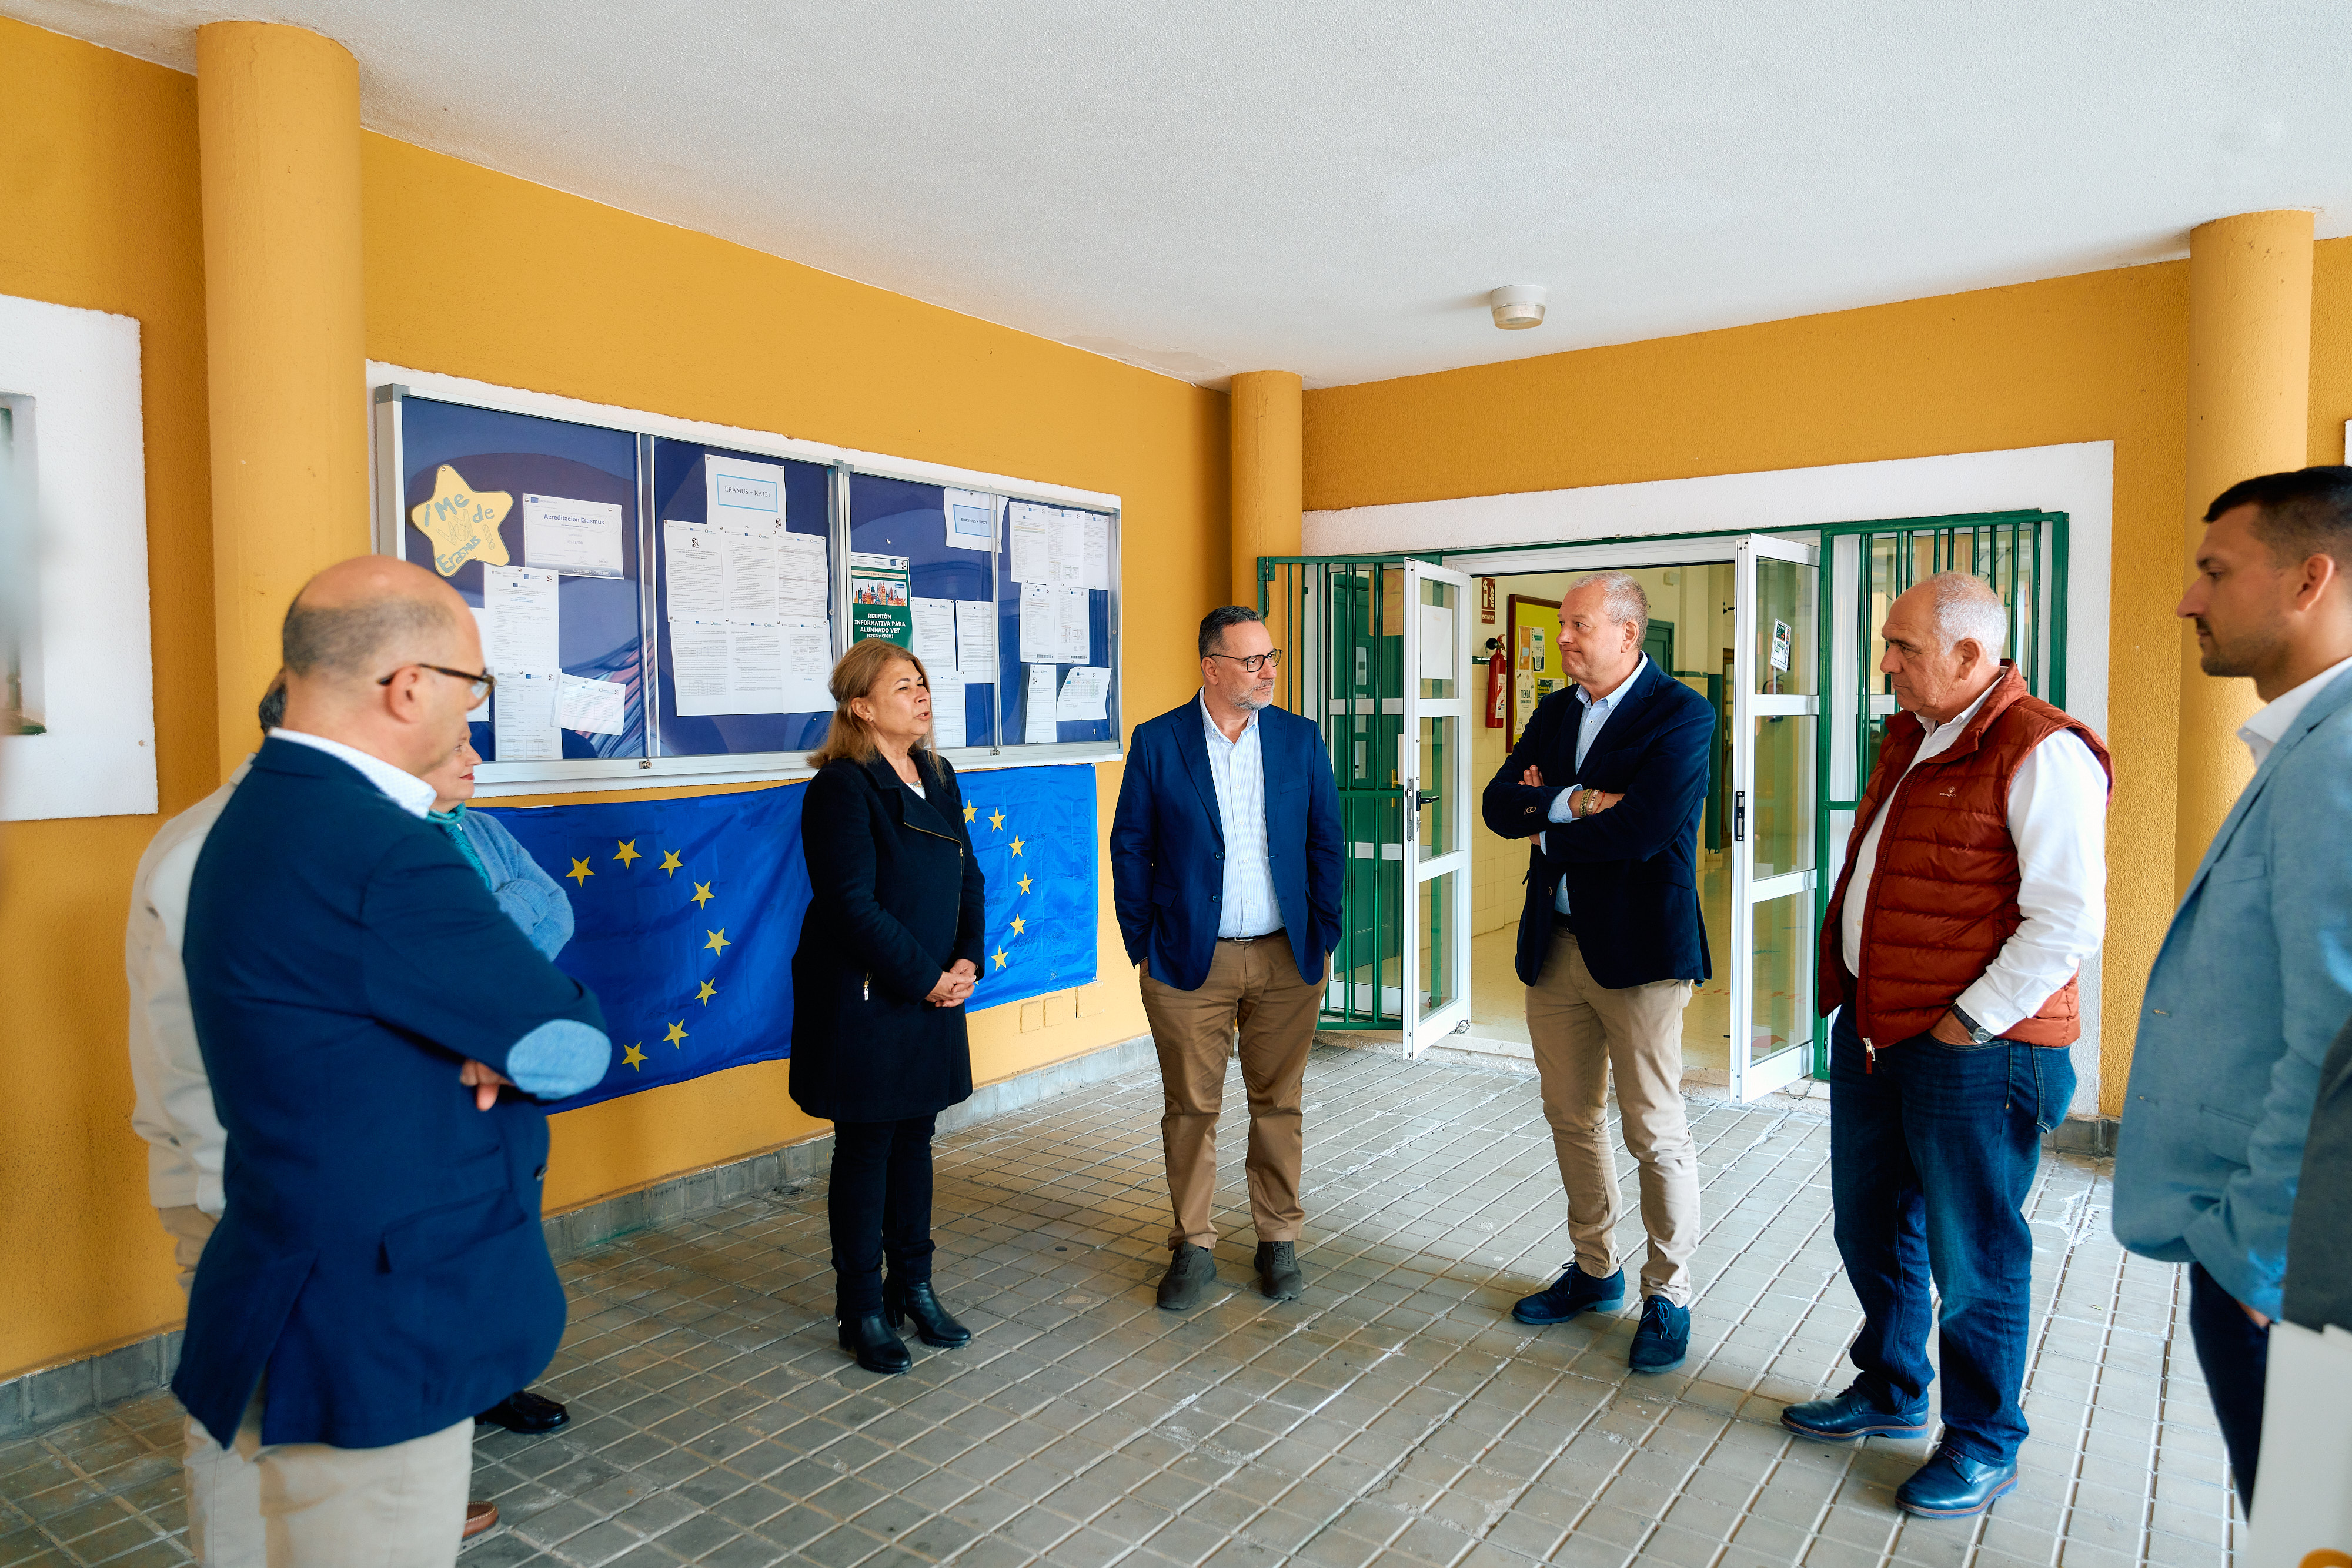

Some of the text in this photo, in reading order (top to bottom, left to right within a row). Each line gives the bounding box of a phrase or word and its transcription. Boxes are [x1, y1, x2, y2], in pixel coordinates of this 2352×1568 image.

[724, 486, 749, 494] ERAMUS
[472, 504, 495, 523] de
[544, 513, 604, 525] Acreditación Erasmus
